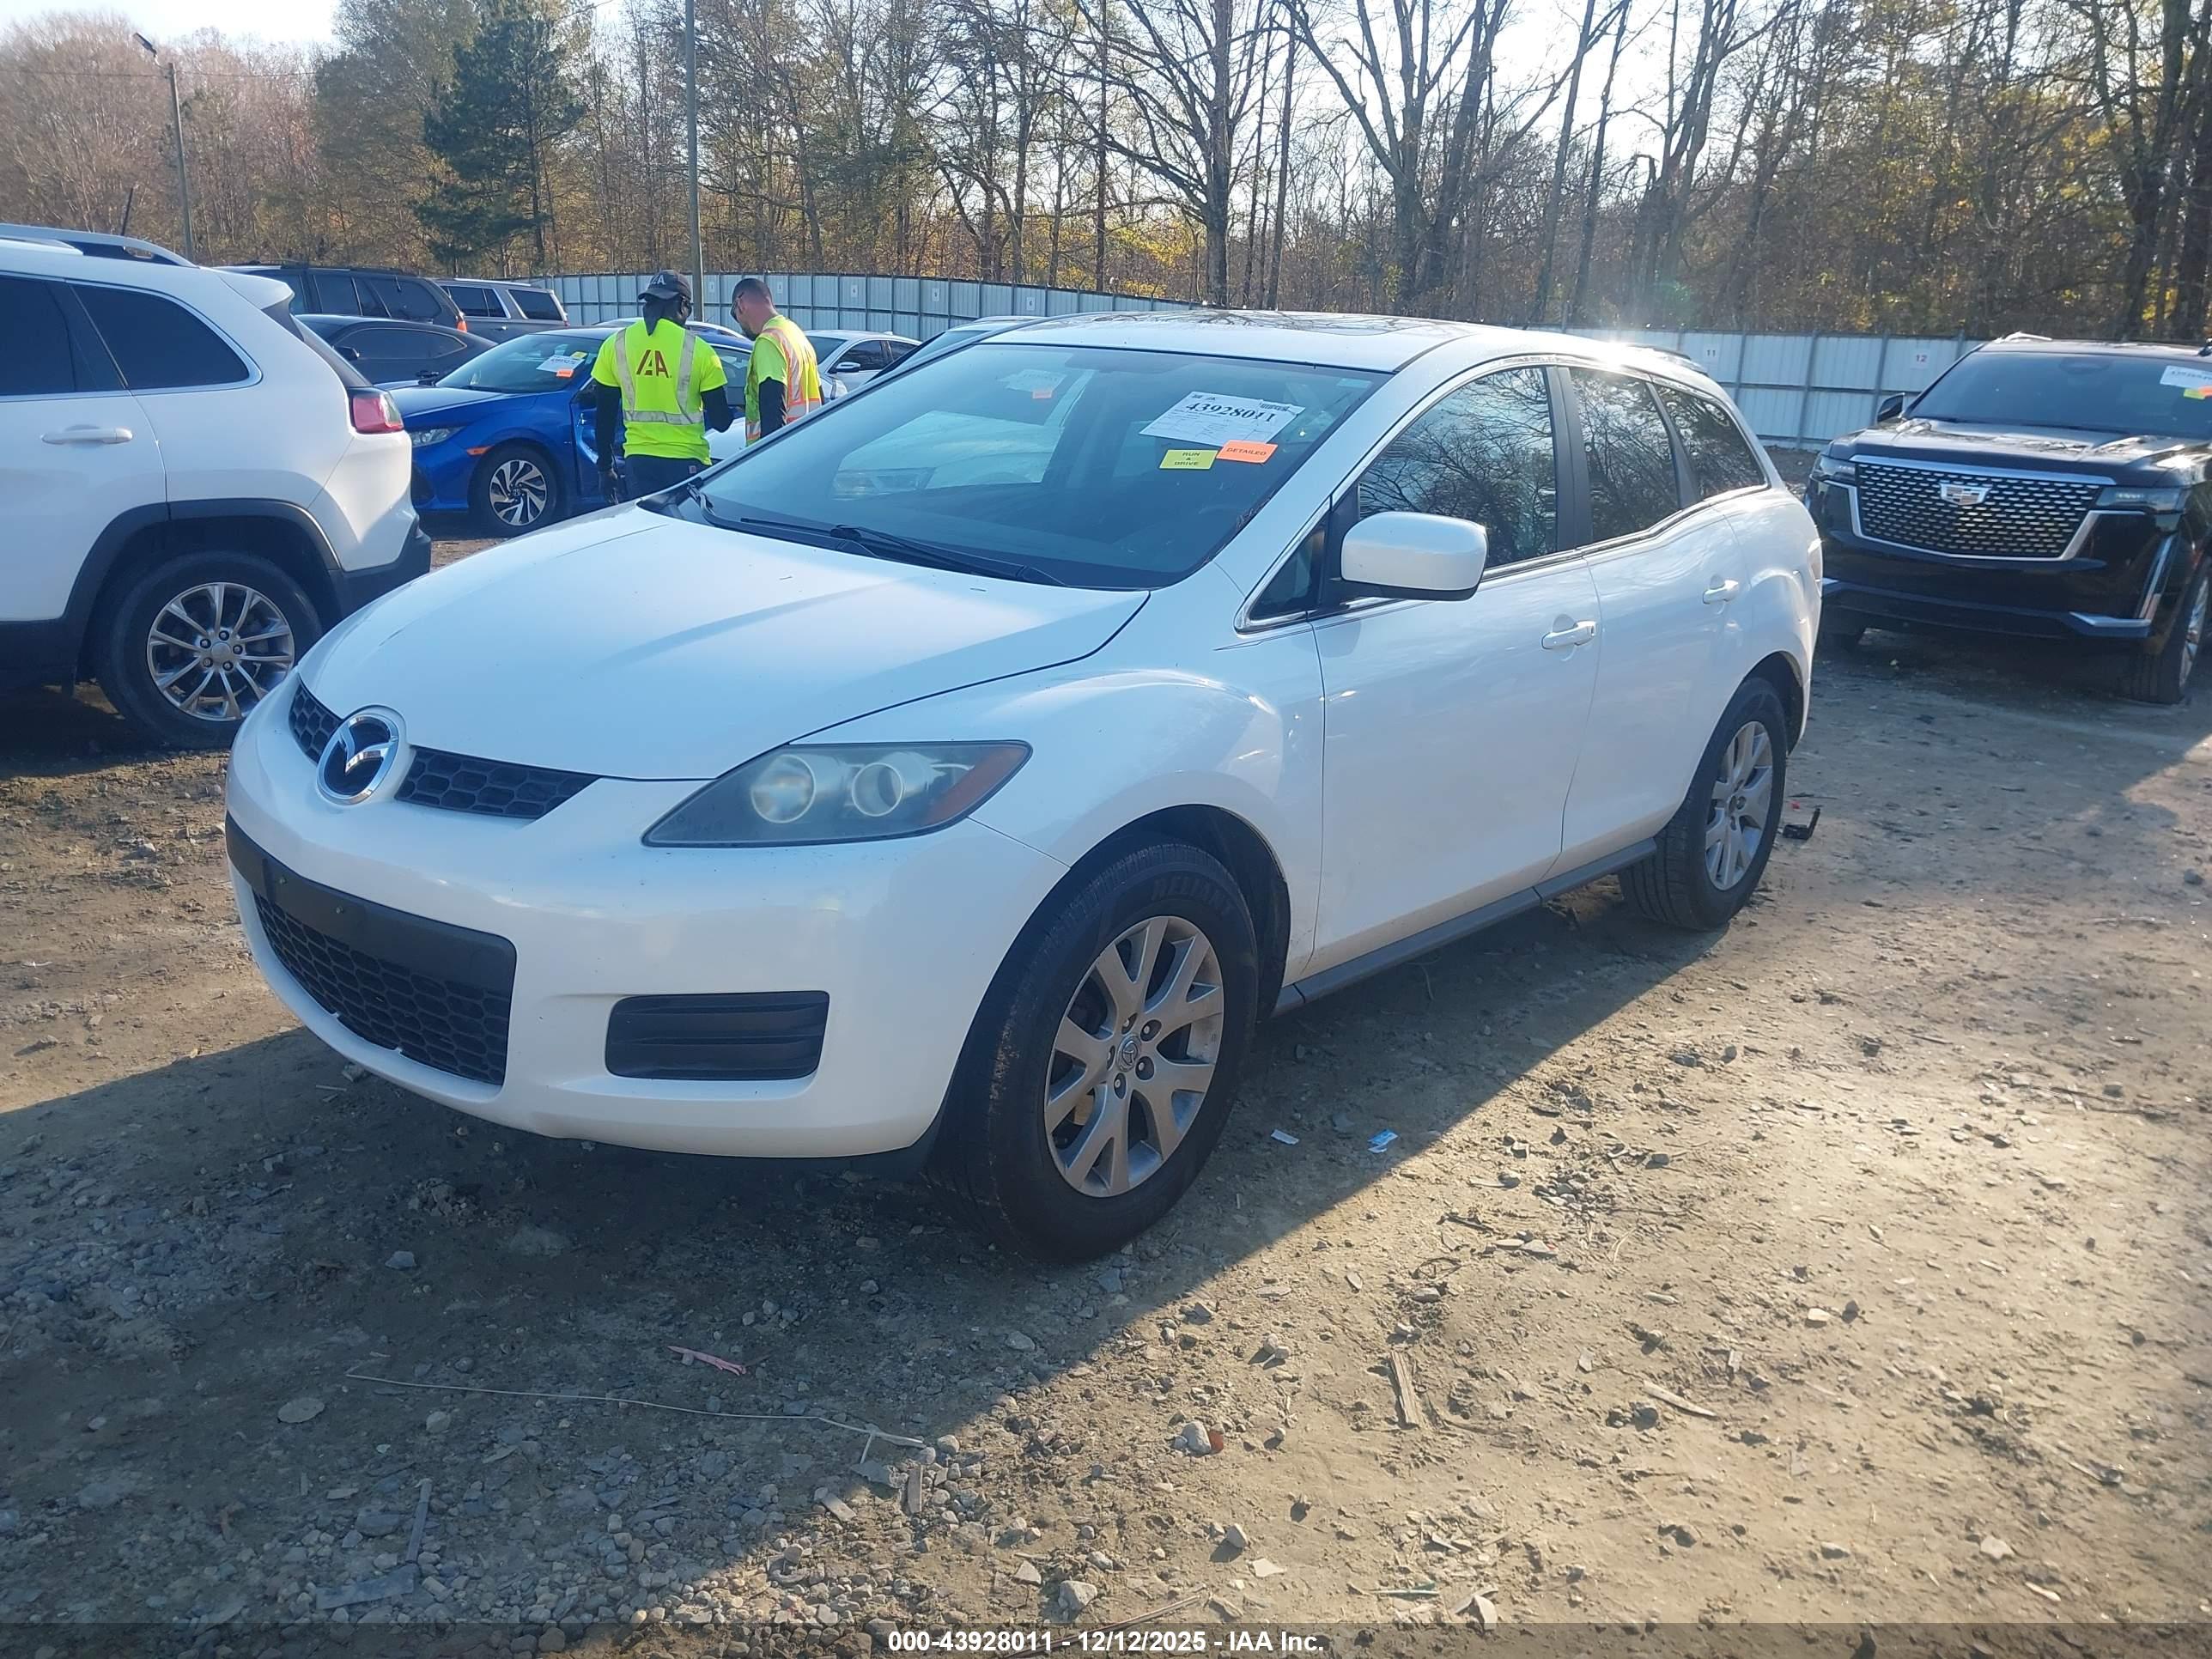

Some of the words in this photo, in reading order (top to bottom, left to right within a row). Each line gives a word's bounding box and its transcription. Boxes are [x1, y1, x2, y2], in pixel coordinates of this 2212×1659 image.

[1916, 354, 1928, 362] 12
[1186, 402, 1277, 422] 43928011
[1226, 447, 1267, 456] DETAILED
